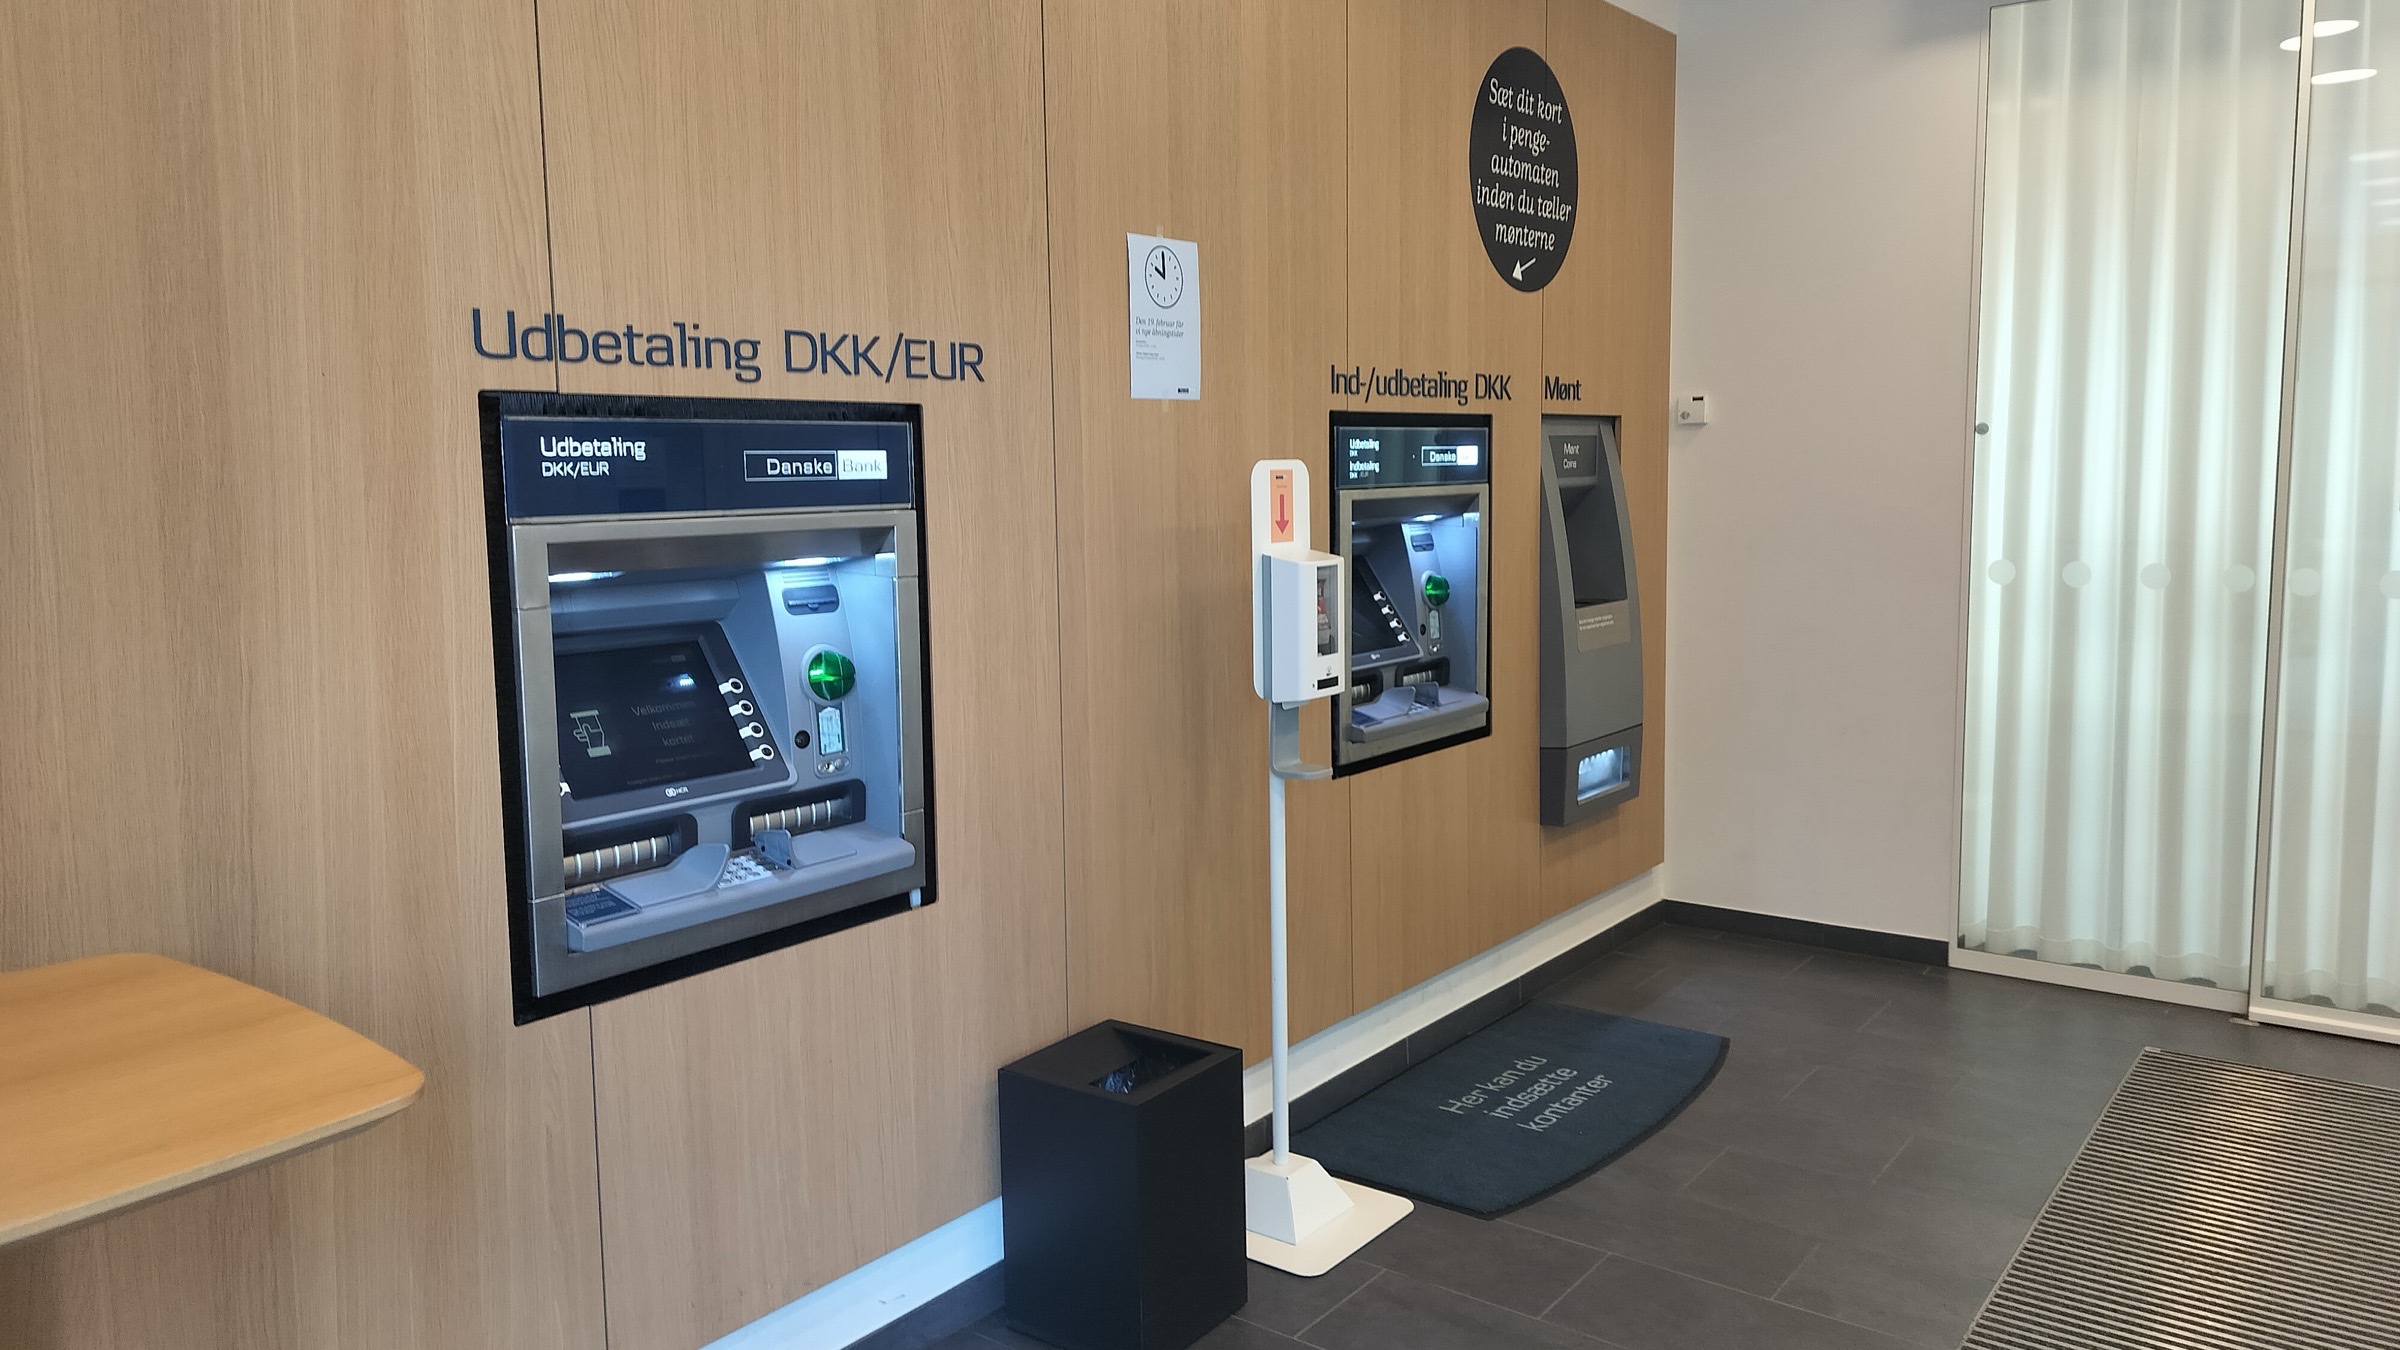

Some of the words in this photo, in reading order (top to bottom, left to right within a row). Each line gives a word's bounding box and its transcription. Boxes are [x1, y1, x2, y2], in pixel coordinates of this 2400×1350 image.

[1489, 77, 1514, 110] Sæt
[1516, 87, 1535, 116] dit
[1537, 93, 1563, 125] kort
[1502, 115, 1507, 142] i
[1509, 124, 1551, 157] penge-
[1491, 153, 1560, 188] automaten
[1476, 178, 1515, 212] inden
[1517, 189, 1535, 216] du
[1537, 193, 1572, 223] tæller
[1495, 221, 1556, 251] mønterne
[472, 307, 761, 383] Udbetaling
[784, 328, 985, 383] DKK/EUR
[1331, 364, 1469, 406] Ind-/udbetaling
[1475, 373, 1512, 401] DKK
[1545, 376, 1582, 401] Mønt
[540, 435, 646, 461] Udbetaling
[1349, 438, 1380, 451] Udbetaling
[541, 461, 609, 478] DKK/EUR
[766, 457, 833, 476] Danske
[842, 458, 882, 474] Bank
[631, 700, 696, 717] Velkommen
[1438, 1088, 1489, 1115] Her
[1475, 1069, 1526, 1092] kan
[1514, 1055, 1548, 1072] du
[1483, 1067, 1578, 1119] indsætte
[1516, 1074, 1613, 1132] kontanter
